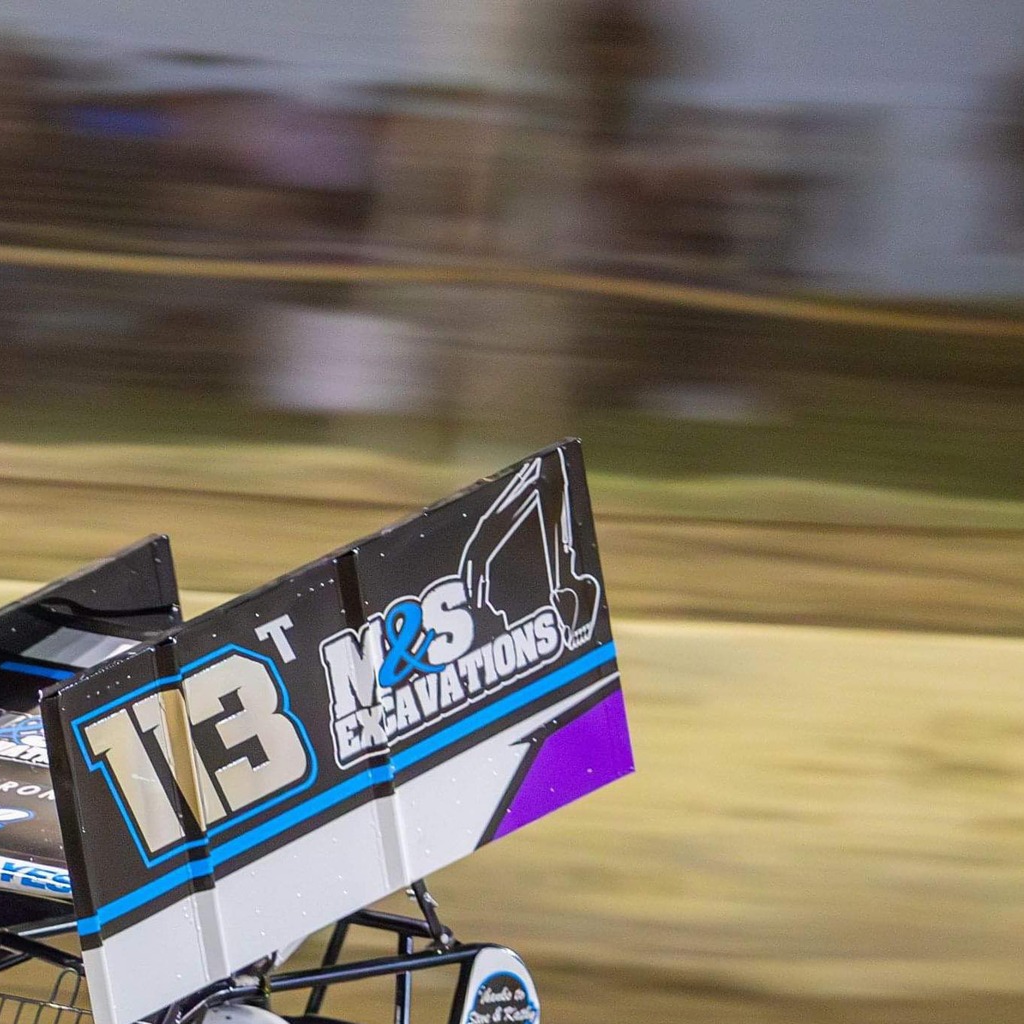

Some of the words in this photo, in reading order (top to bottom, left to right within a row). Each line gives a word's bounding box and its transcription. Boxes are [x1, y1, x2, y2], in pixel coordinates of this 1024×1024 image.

[254, 614, 296, 664] T
[322, 579, 475, 719] M&S
[334, 611, 560, 760] EXCAVATIONS
